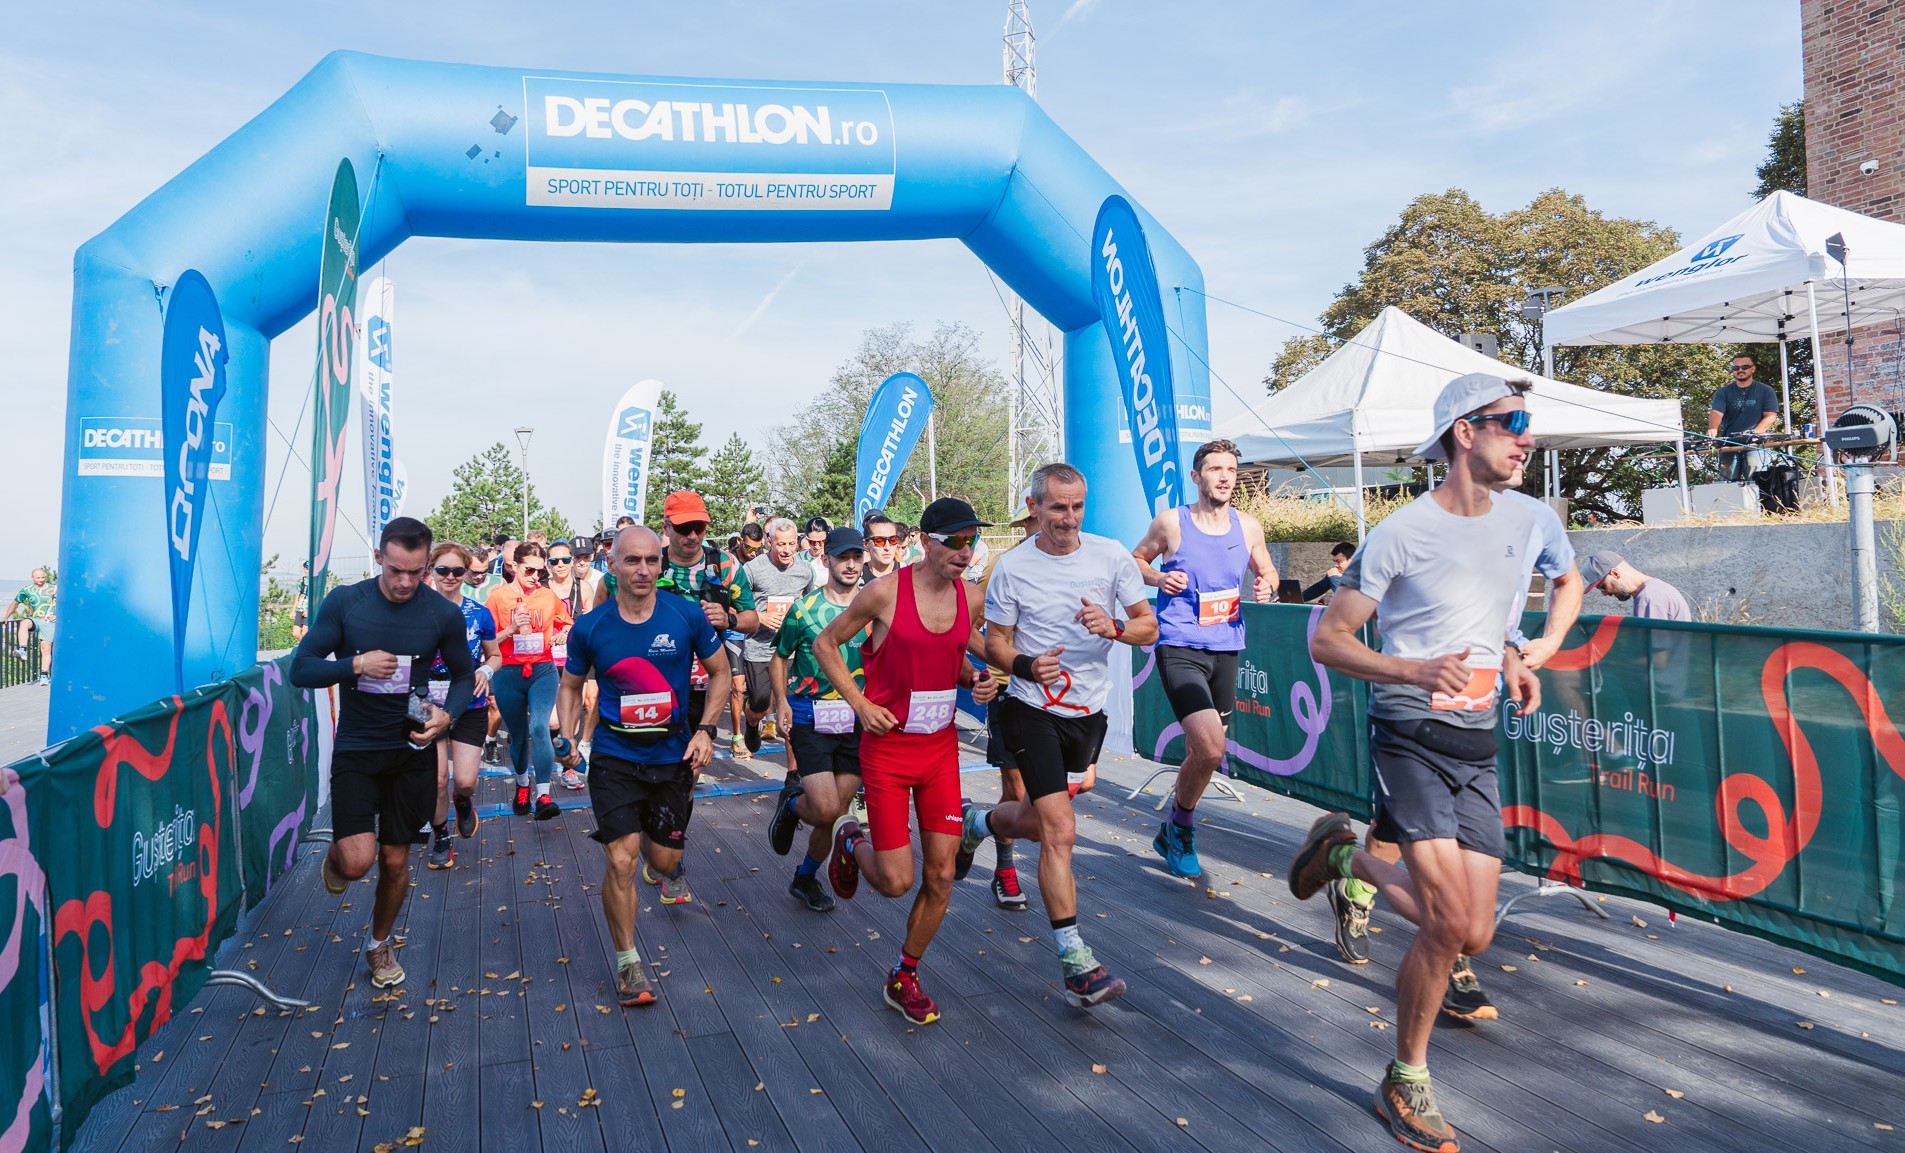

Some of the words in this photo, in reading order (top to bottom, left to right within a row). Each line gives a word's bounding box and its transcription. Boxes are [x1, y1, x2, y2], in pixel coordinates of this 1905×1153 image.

[544, 95, 879, 146] DECATHLON.ro
[547, 178, 601, 195] SPORT
[604, 179, 669, 198] PENTRU
[716, 182, 763, 198] TOTUL
[767, 183, 827, 199] PENTRU
[829, 184, 877, 199] SPORT
[1634, 253, 1750, 287] wenglor
[869, 385, 919, 501] DECATHLON
[611, 462, 621, 511] innovative
[775, 603, 787, 613] 11
[1210, 600, 1229, 614] 10
[517, 641, 541, 651] 239
[634, 706, 659, 721] 14
[819, 709, 850, 722] 228
[913, 703, 950, 721] 248
[1252, 699, 1271, 718] Run
[1503, 698, 1675, 770] Gușterița
[1590, 763, 1633, 791] Trail
[1637, 772, 1675, 801] Run
